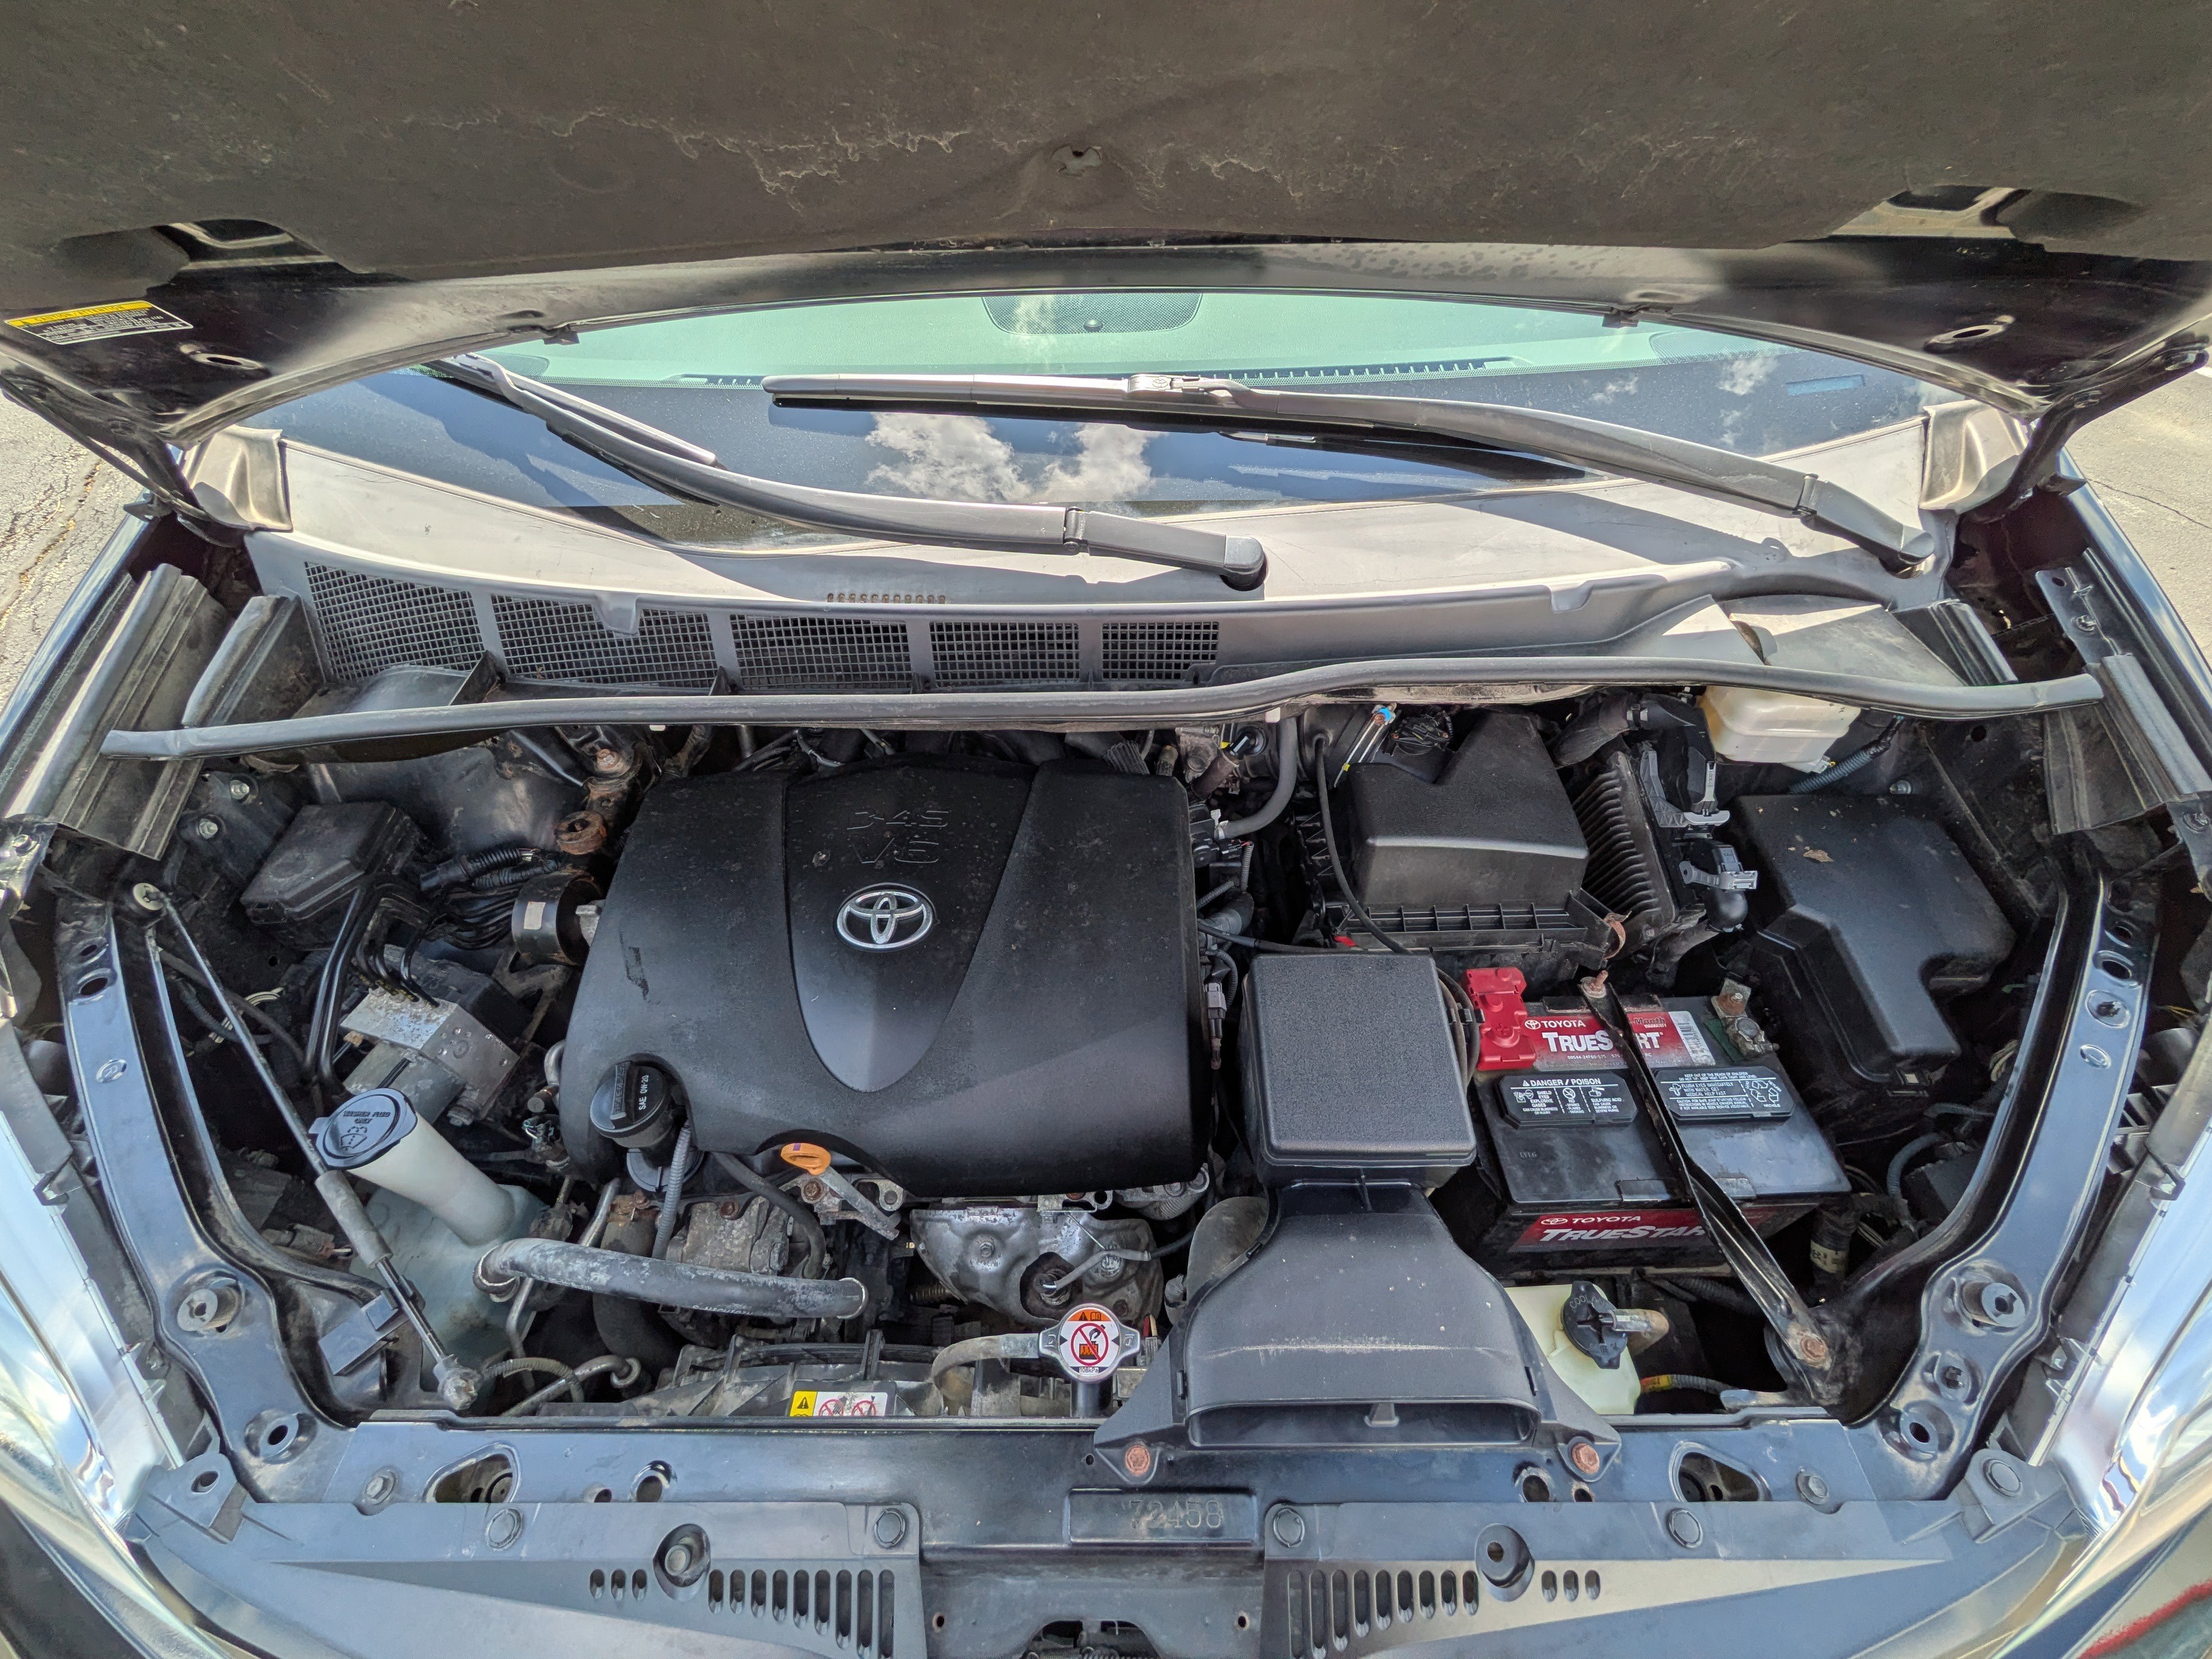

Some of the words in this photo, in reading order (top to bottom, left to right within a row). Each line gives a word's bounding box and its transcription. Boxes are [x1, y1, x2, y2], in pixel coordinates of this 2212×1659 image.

[853, 837, 939, 863] V6
[1541, 1020, 1587, 1029] TOYOTA
[1542, 1030, 1660, 1052] TRUESRT
[639, 1096, 647, 1110] SAE
[1572, 1215, 1641, 1224] TOYOTA
[1540, 1225, 1706, 1242] TRUESTAR
